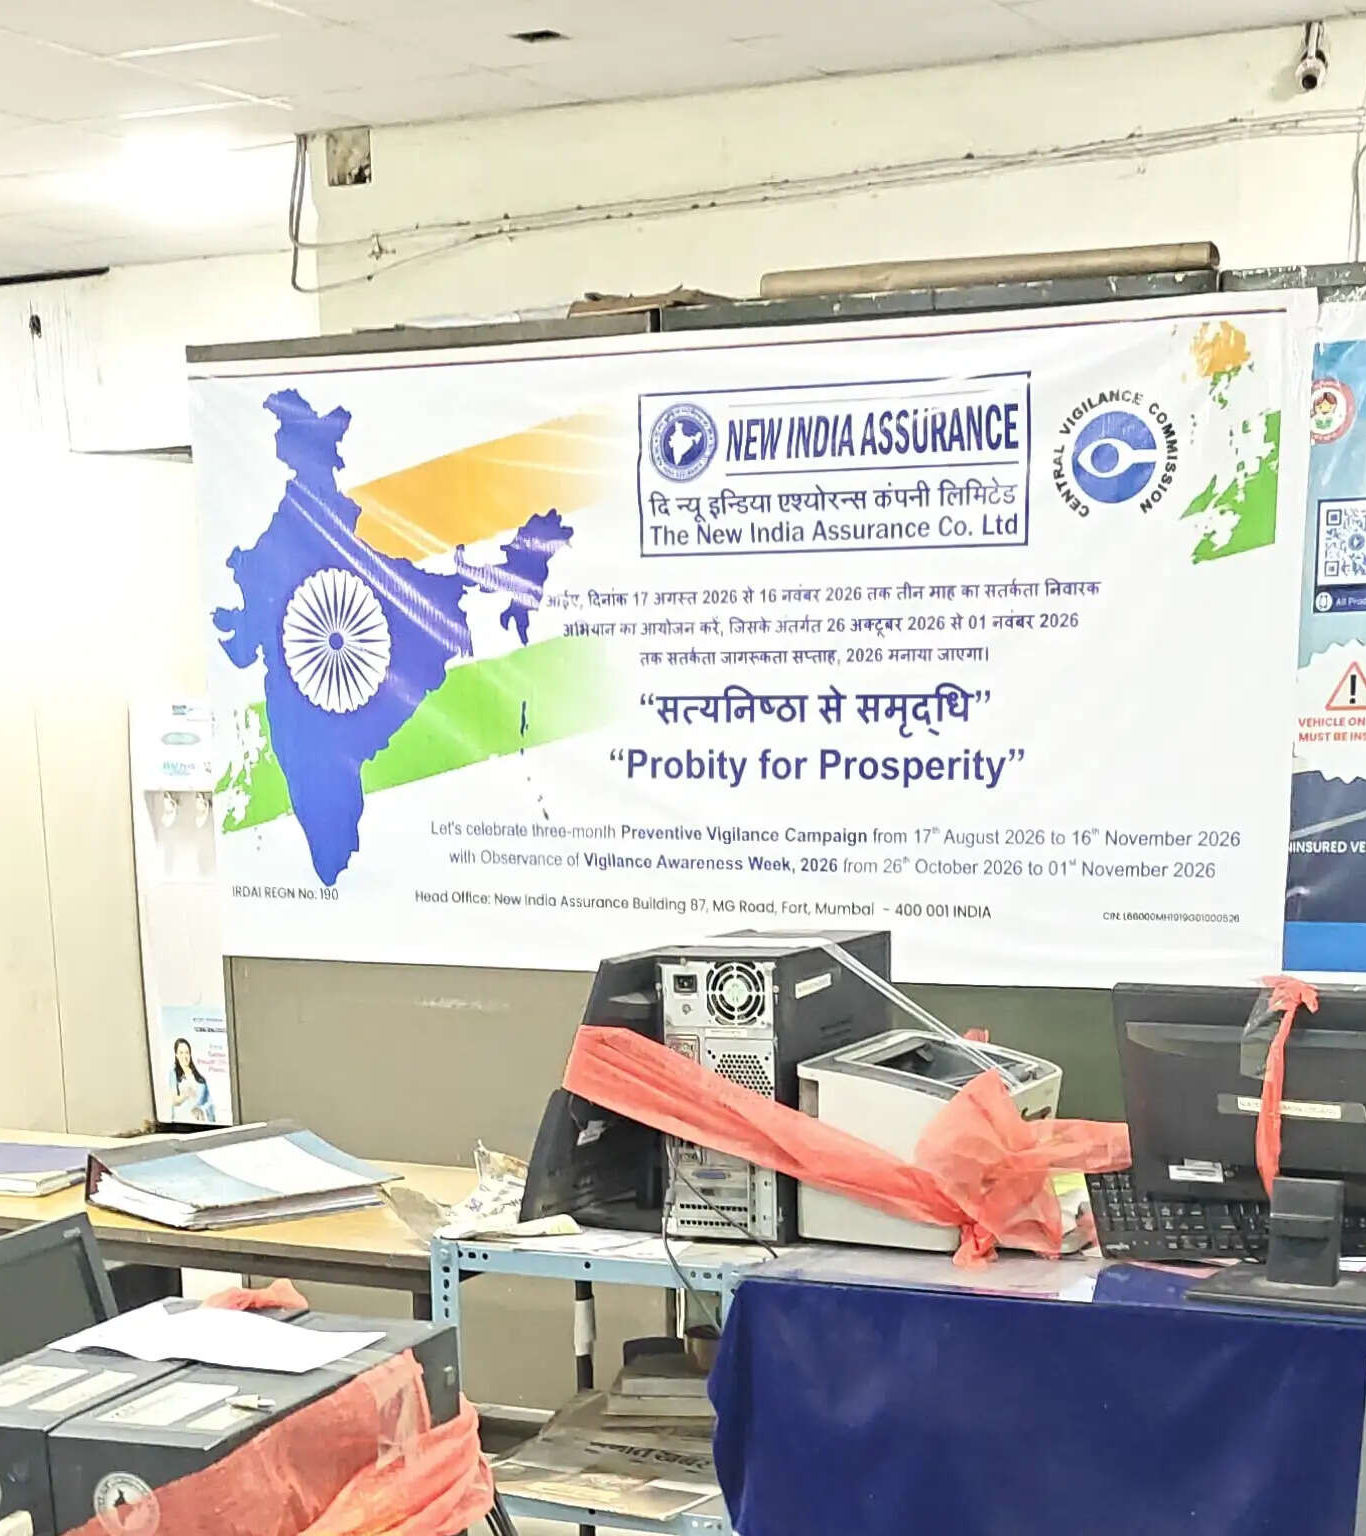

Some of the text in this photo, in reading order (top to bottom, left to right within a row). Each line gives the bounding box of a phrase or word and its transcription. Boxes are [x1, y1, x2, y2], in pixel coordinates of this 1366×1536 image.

[1059, 389, 1143, 435] VIGILANCE
[727, 403, 1019, 462] NEW INDIA ASSURANCE
[1139, 402, 1178, 513] COMMISSION
[1053, 445, 1090, 517] CENTRAL
[649, 492, 670, 516] दि
[676, 496, 706, 522] न्यू
[709, 489, 770, 519] इन्डिया
[874, 480, 930, 509] कंपनी
[939, 478, 1016, 506] लिमिटेड
[650, 513, 1018, 546] The New India Assurance Co. Ltd
[640, 652, 662, 665] तक
[667, 647, 715, 665] सतर्कता
[846, 649, 883, 662] 2026
[887, 648, 933, 662] मनाया
[818, 685, 846, 723] से
[1298, 717, 1346, 727] VEHICLE
[1348, 717, 1366, 726] ON
[1298, 732, 1331, 742] MUST
[1334, 732, 1347, 741] BE
[610, 748, 1025, 788] “Probity for Prosperity”
[431, 822, 462, 836] Let's
[467, 822, 527, 837] celebrate
[532, 823, 615, 839] three-month
[621, 825, 702, 841] Preventive
[707, 827, 779, 844] Vigilance
[784, 828, 867, 846] Campaign
[873, 829, 907, 844] from
[944, 829, 999, 848] August
[1005, 830, 1045, 845] 2026
[1051, 831, 1065, 845] to
[1105, 831, 1192, 847] November
[1198, 831, 1241, 847] 2026
[449, 850, 476, 865] with
[481, 850, 563, 867] Observance
[566, 852, 580, 867] of
[584, 853, 651, 870] Vigilance
[657, 855, 743, 871] Awareness
[748, 856, 796, 875] Week,
[801, 858, 837, 873] 2026
[843, 859, 878, 873] from
[915, 859, 977, 876] October
[984, 860, 1022, 876] 2026
[1028, 862, 1043, 876] to
[1082, 862, 1168, 878] November
[1173, 862, 1216, 879] 2026
[232, 885, 261, 898] IRDAI
[265, 887, 295, 899] REGN
[320, 888, 338, 900] 190
